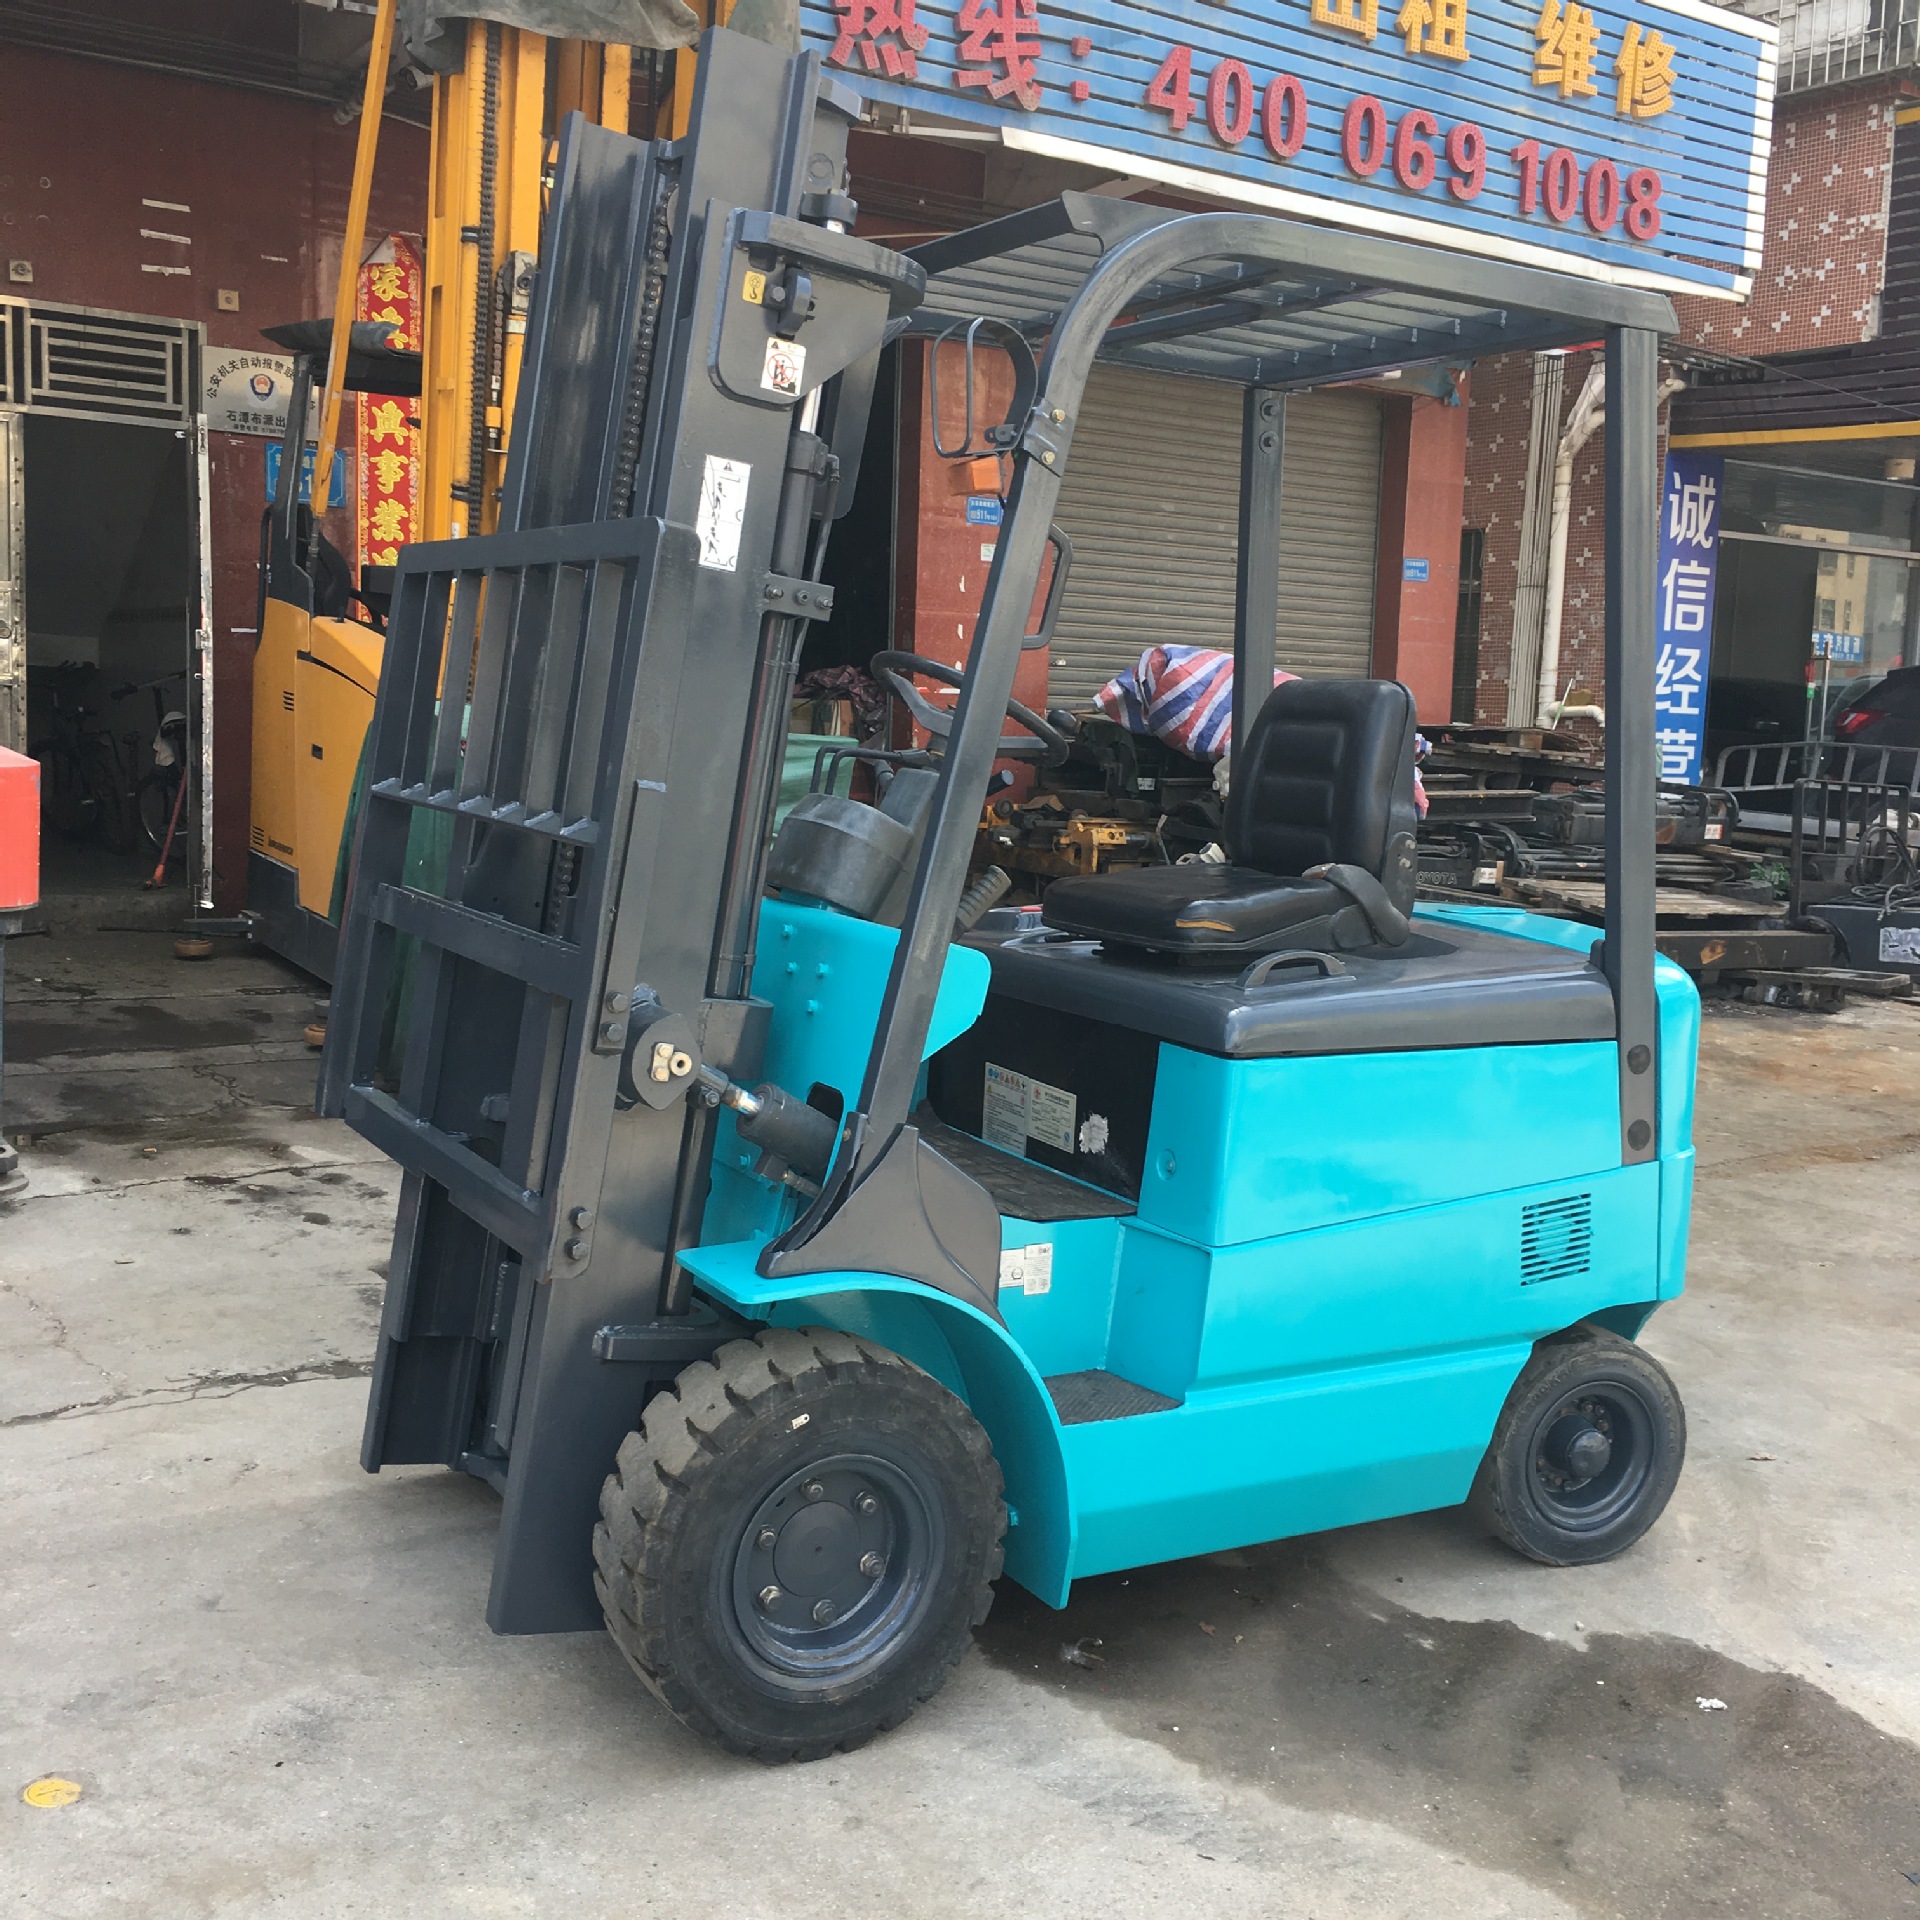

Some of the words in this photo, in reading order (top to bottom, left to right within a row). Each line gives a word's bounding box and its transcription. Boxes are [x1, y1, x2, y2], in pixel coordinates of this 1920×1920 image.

[1532, 1, 1678, 118] 维修
[1144, 44, 1308, 159] 400
[1341, 94, 1487, 201] 069
[1511, 138, 1662, 241] 1008
[1656, 472, 1717, 785] 诚信经营
[1416, 870, 1458, 885] OYOTA
